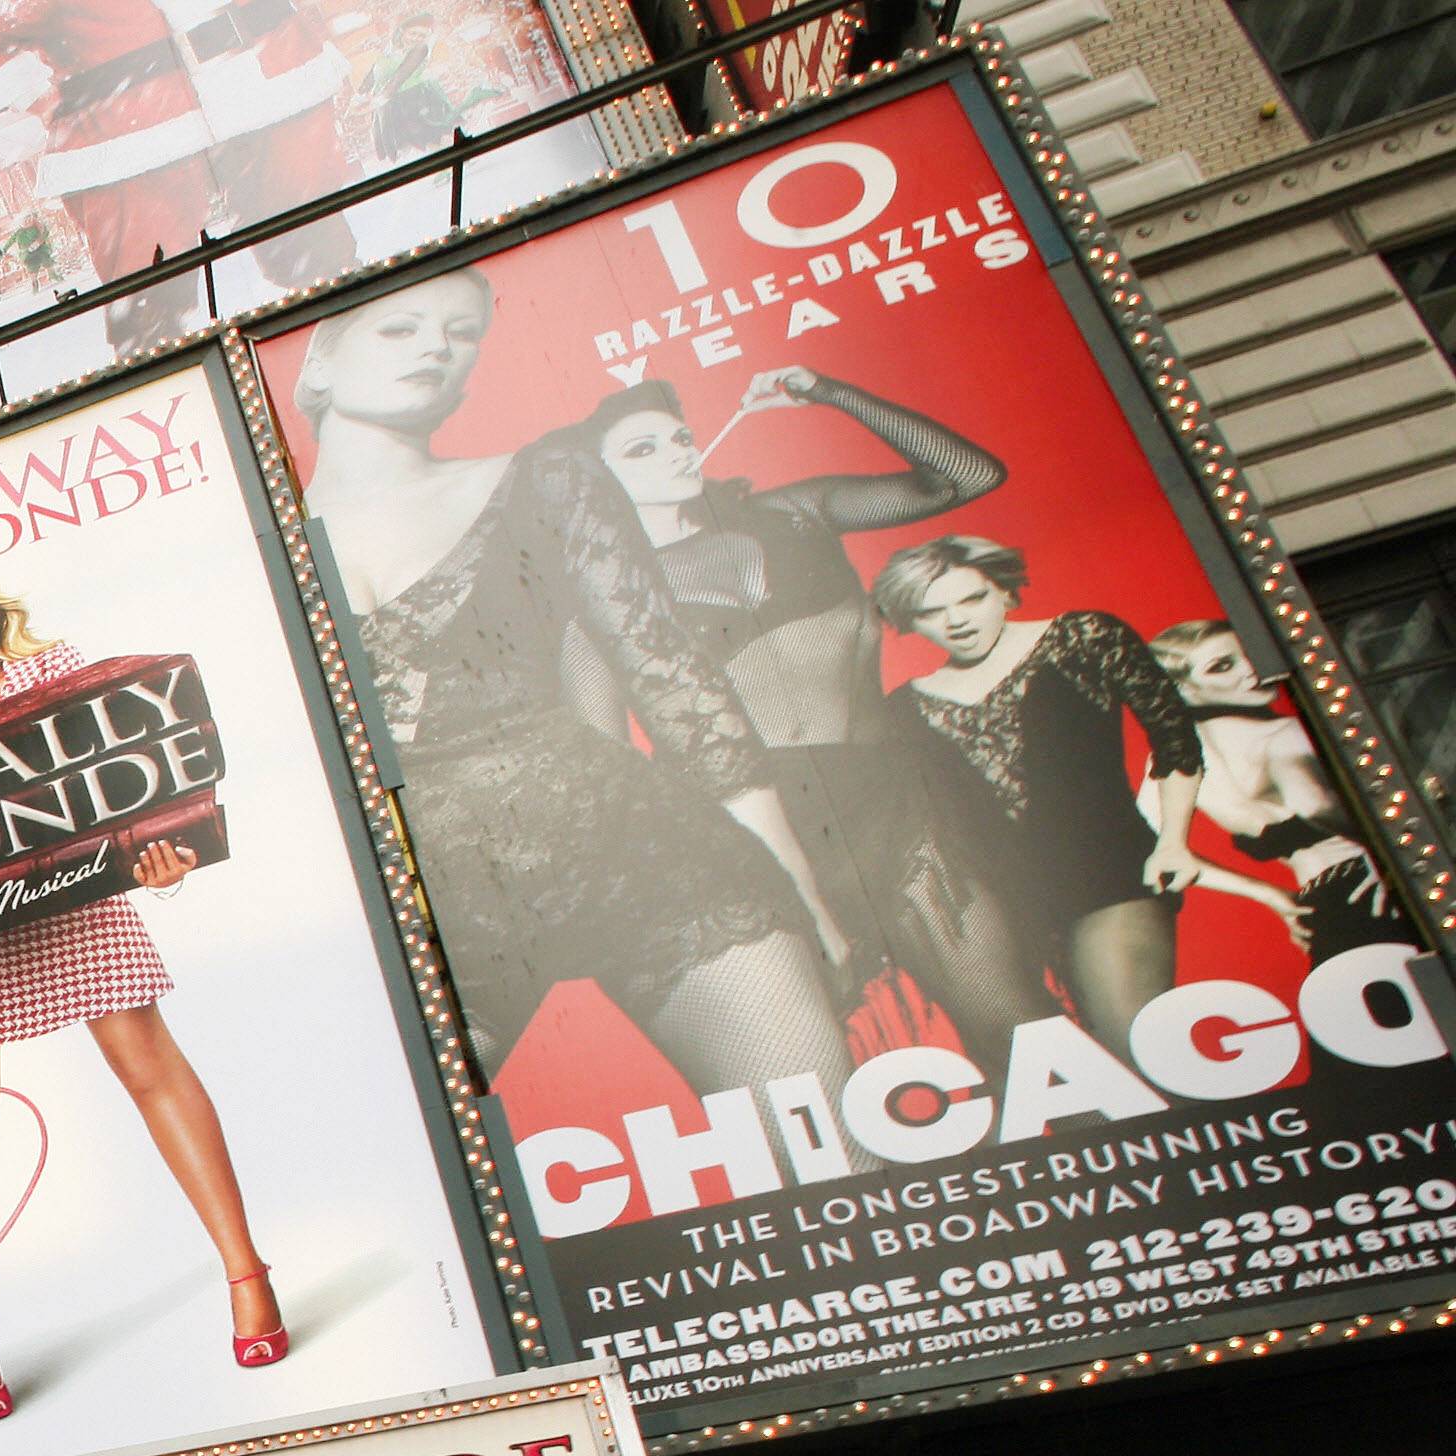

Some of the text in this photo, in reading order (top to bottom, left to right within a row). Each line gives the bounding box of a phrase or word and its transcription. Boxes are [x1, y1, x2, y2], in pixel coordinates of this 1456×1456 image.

[594, 192, 1014, 364] RAZZLE-DAZZLE
[624, 140, 898, 296] 10
[606, 228, 1030, 384] YEARS
[515, 942, 1449, 1239] CHICAGO
[588, 1251, 786, 1313] REVIVAL
[803, 1238, 853, 1272] IN
[873, 1175, 1166, 1257] BROADWAY
[684, 1107, 1310, 1257] THE LONGEST-RUNNING
[585, 1247, 1068, 1361] TELECHARGE.COM
[629, 1321, 867, 1384] AMBASSADOR
[868, 1291, 1038, 1338] THEATRE
[1060, 1276, 1123, 1305] 219
[1125, 1254, 1239, 1293] WEST
[1246, 1231, 1354, 1271] 49TH
[749, 1339, 913, 1385] ANNIVERSARY
[917, 1320, 1022, 1353] EDITION
[1293, 1248, 1441, 1290] AVAILABLE
